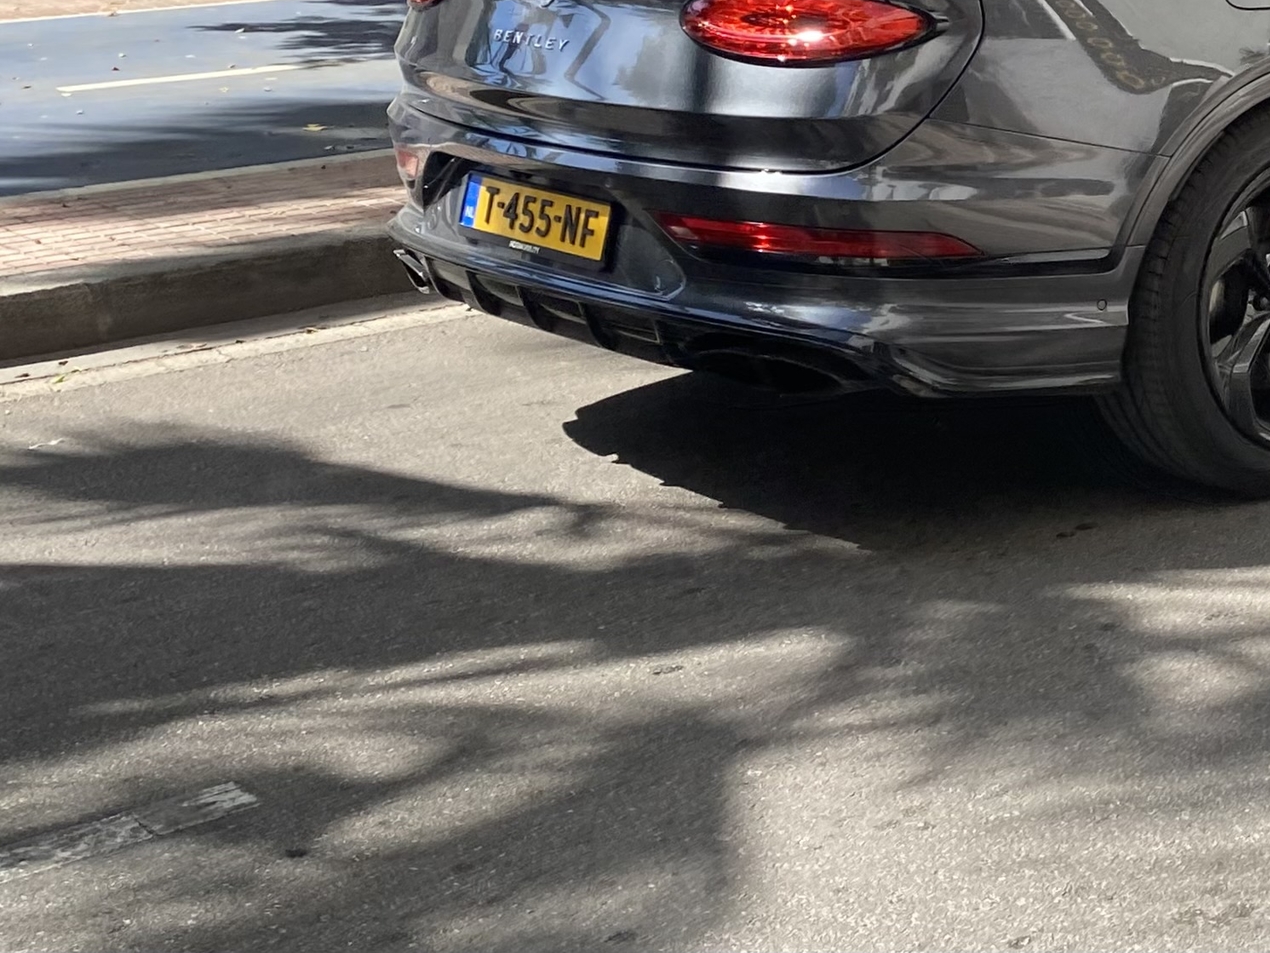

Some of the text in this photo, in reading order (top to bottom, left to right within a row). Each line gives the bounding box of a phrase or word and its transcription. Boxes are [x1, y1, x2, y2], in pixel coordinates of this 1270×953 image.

[493, 28, 570, 52] BENTLEY
[465, 205, 474, 218] NL
[485, 185, 600, 249] T-455-NF
